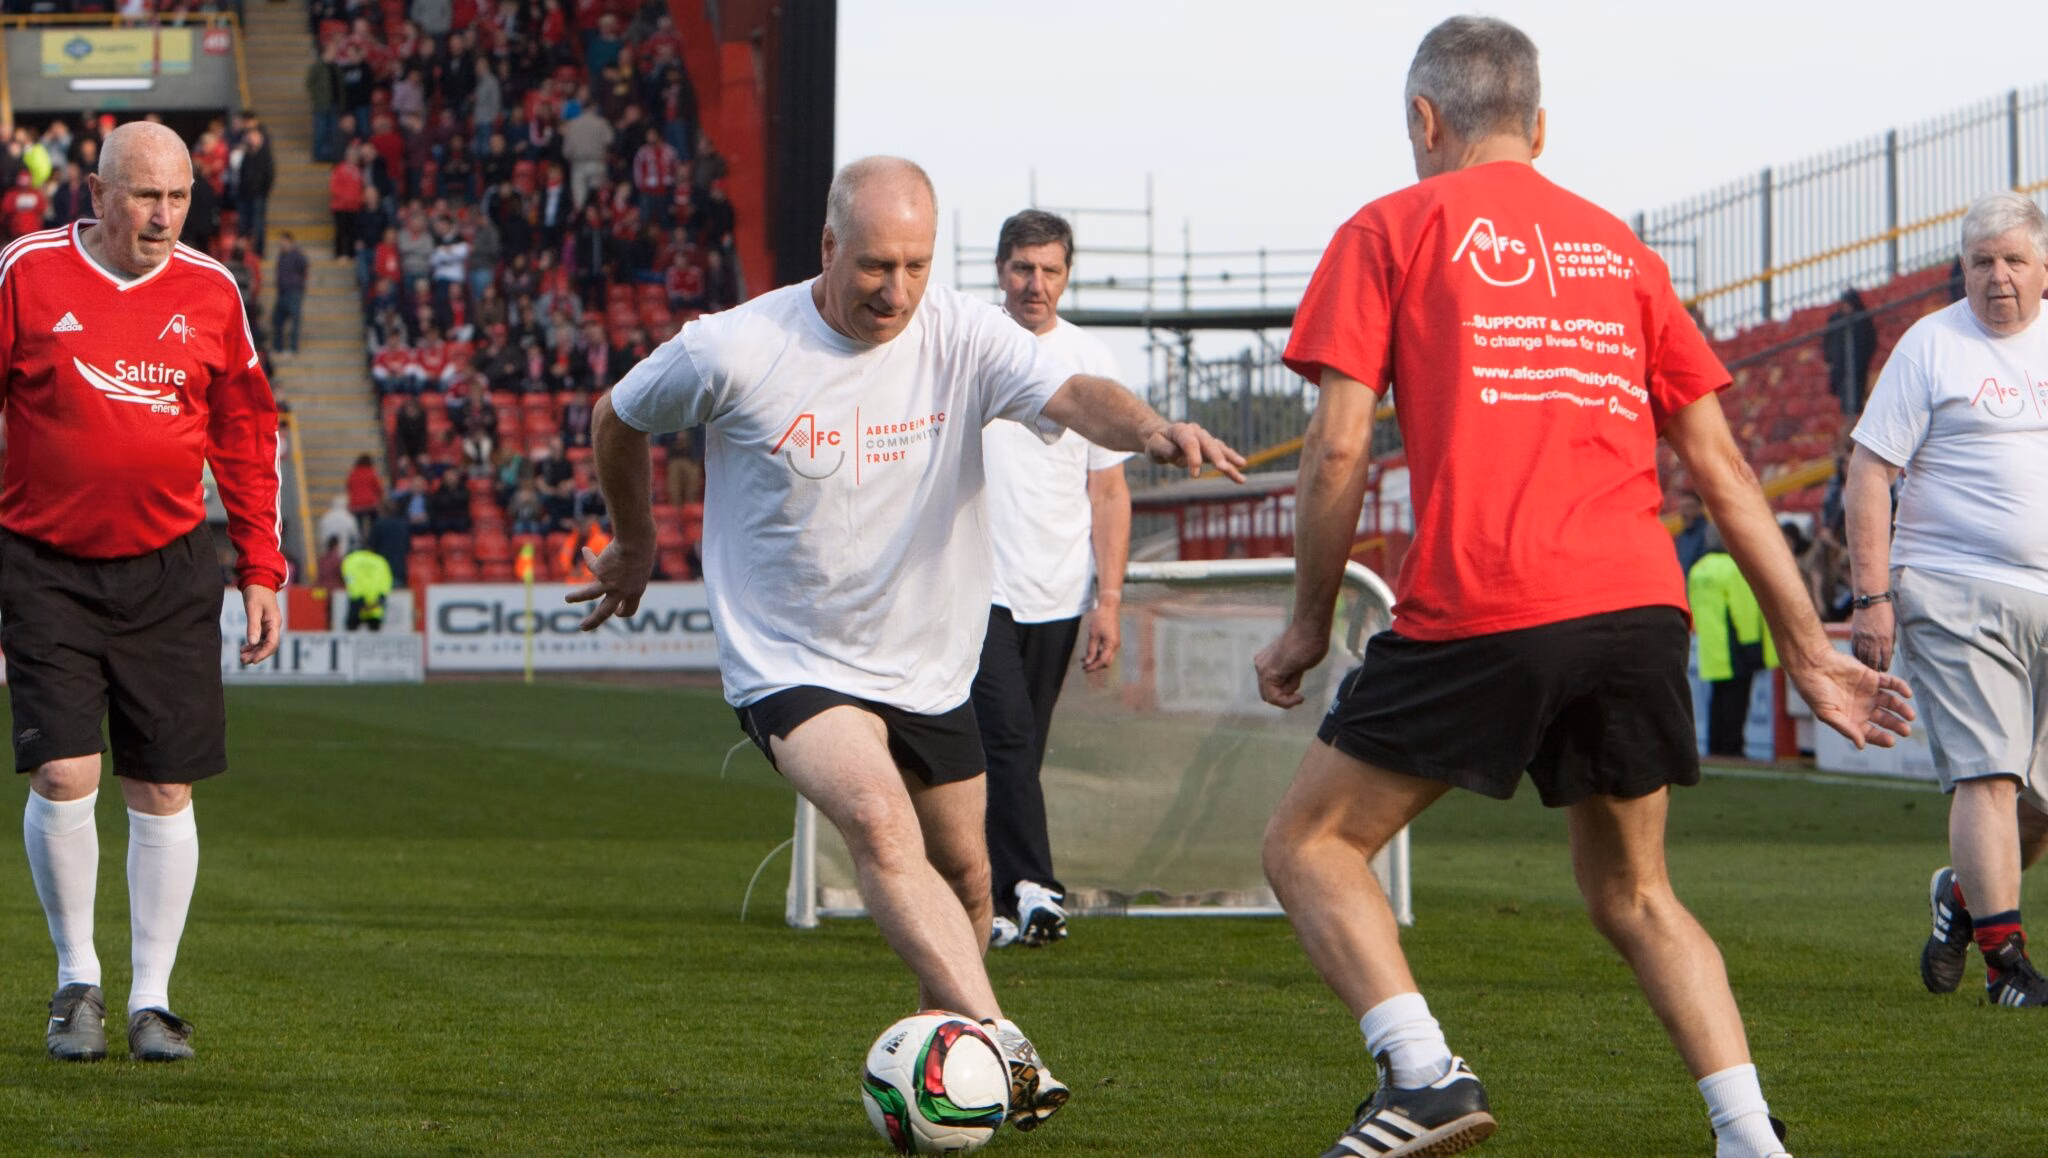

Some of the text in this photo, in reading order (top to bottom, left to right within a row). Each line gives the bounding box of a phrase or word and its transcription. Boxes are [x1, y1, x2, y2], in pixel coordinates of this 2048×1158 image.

[1558, 265, 1605, 278] TRUST
[52, 324, 84, 333] adidas
[1550, 319, 1562, 331] &
[1473, 333, 1487, 347] to
[1490, 334, 1542, 351] change
[1545, 334, 1578, 348] lives
[1579, 335, 1594, 351] for
[1596, 341, 1620, 355] the
[115, 359, 187, 386] Saltire
[151, 403, 180, 416] energy
[930, 412, 946, 424] FC
[770, 414, 841, 459] AFC
[866, 427, 942, 449] COMMUNITY
[866, 450, 907, 463] TRUST
